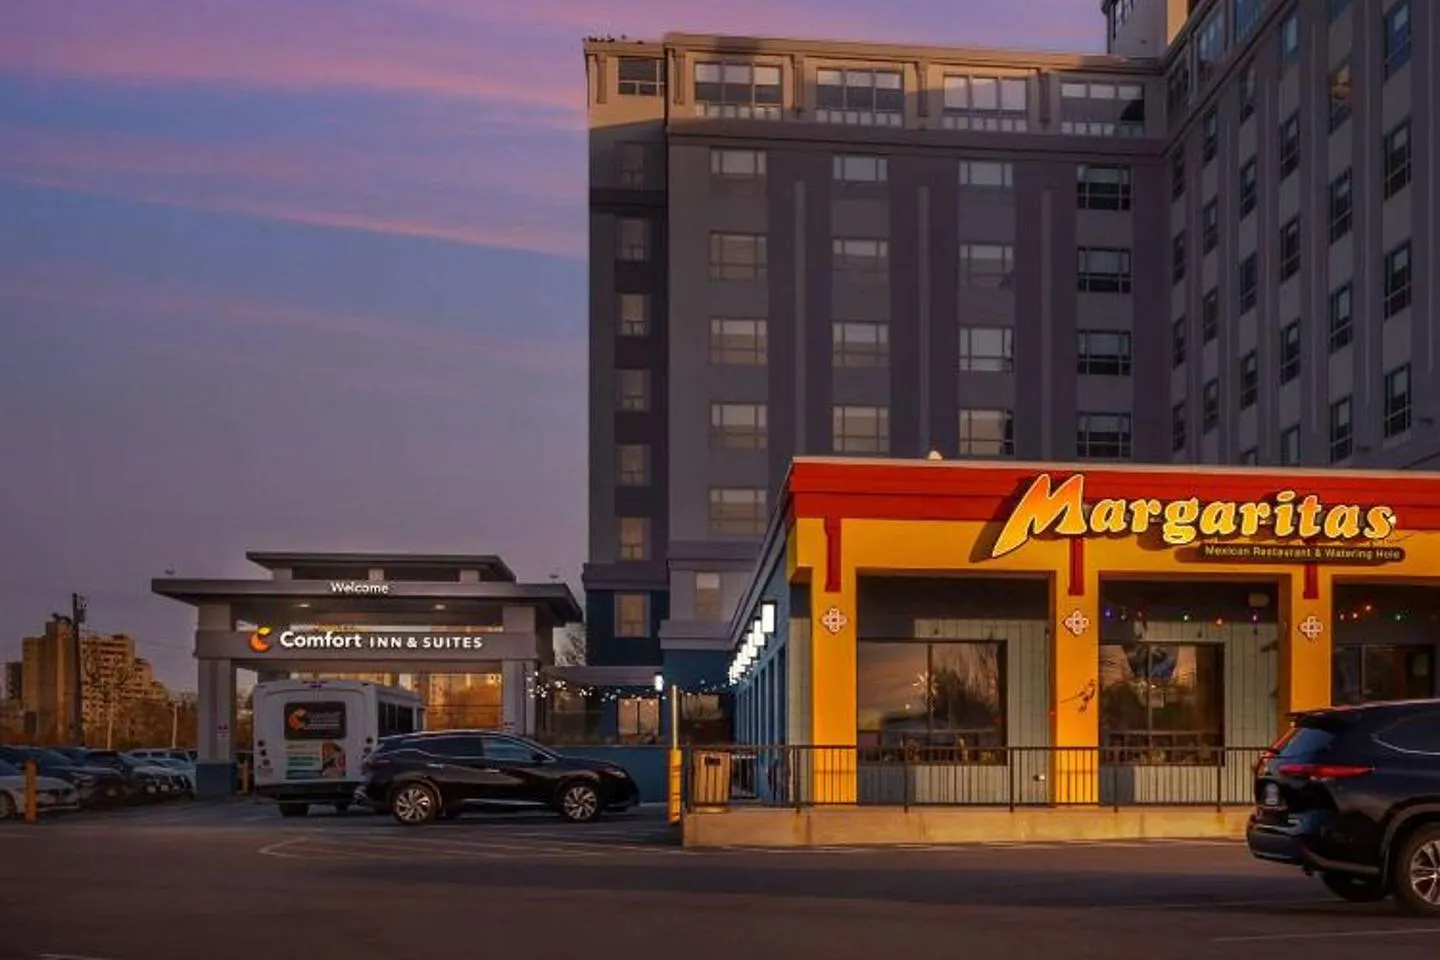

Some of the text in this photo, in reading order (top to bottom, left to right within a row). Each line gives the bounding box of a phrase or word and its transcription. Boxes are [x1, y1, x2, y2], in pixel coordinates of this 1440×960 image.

[992, 474, 1396, 558] Margaritas
[1204, 545, 1250, 557] Mexican
[1324, 548, 1373, 561] Watering
[330, 580, 390, 595] Welcome
[280, 631, 362, 649] Comfort
[369, 637, 402, 649] INN
[406, 637, 417, 649] &
[422, 637, 483, 649] SUITES
